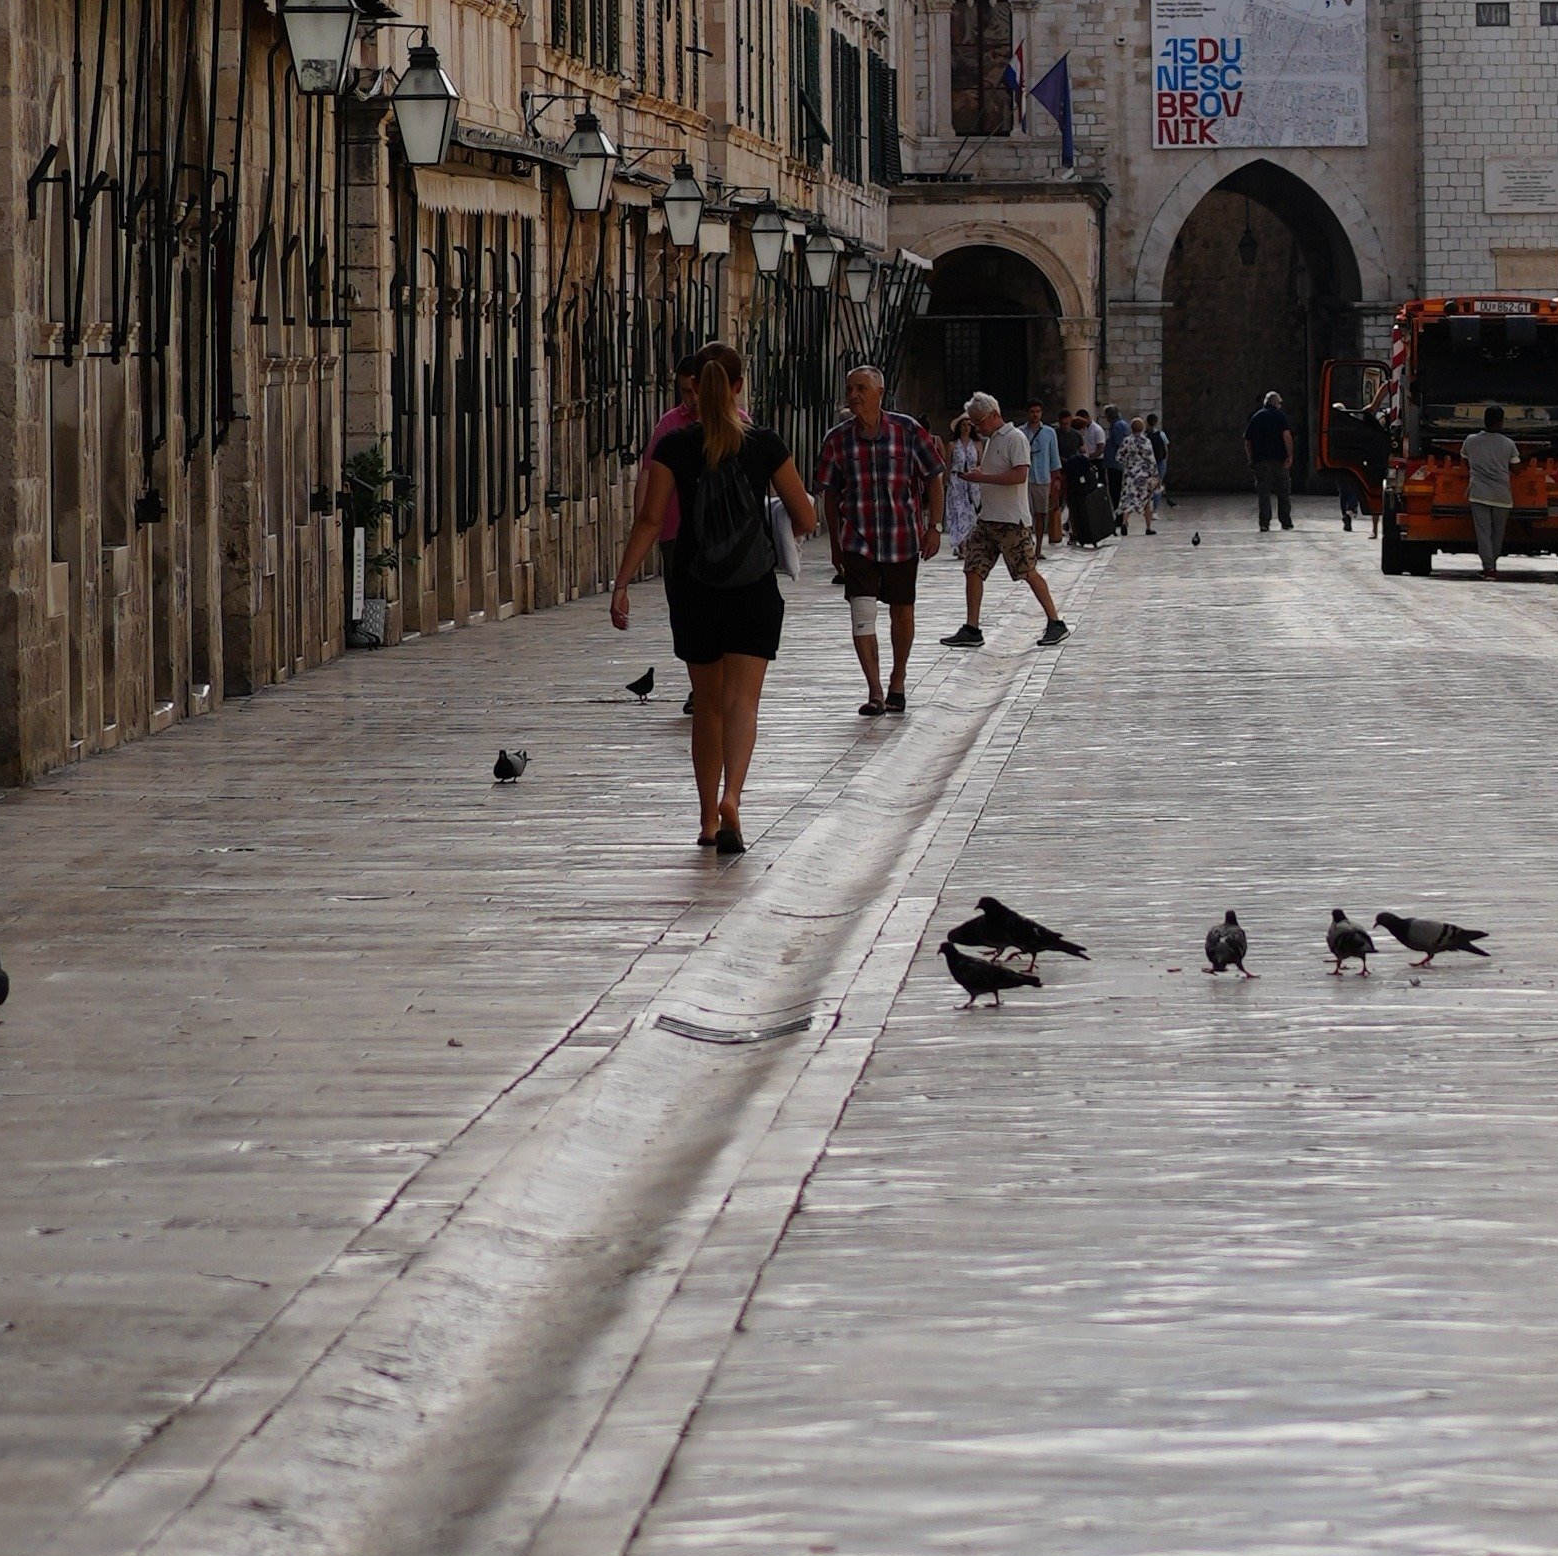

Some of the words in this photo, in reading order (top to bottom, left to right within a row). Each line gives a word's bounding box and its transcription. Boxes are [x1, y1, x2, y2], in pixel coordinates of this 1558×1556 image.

[1157, 65, 1242, 91] NESC
[1157, 91, 1243, 118] BROV
[1158, 119, 1219, 145] NIK
